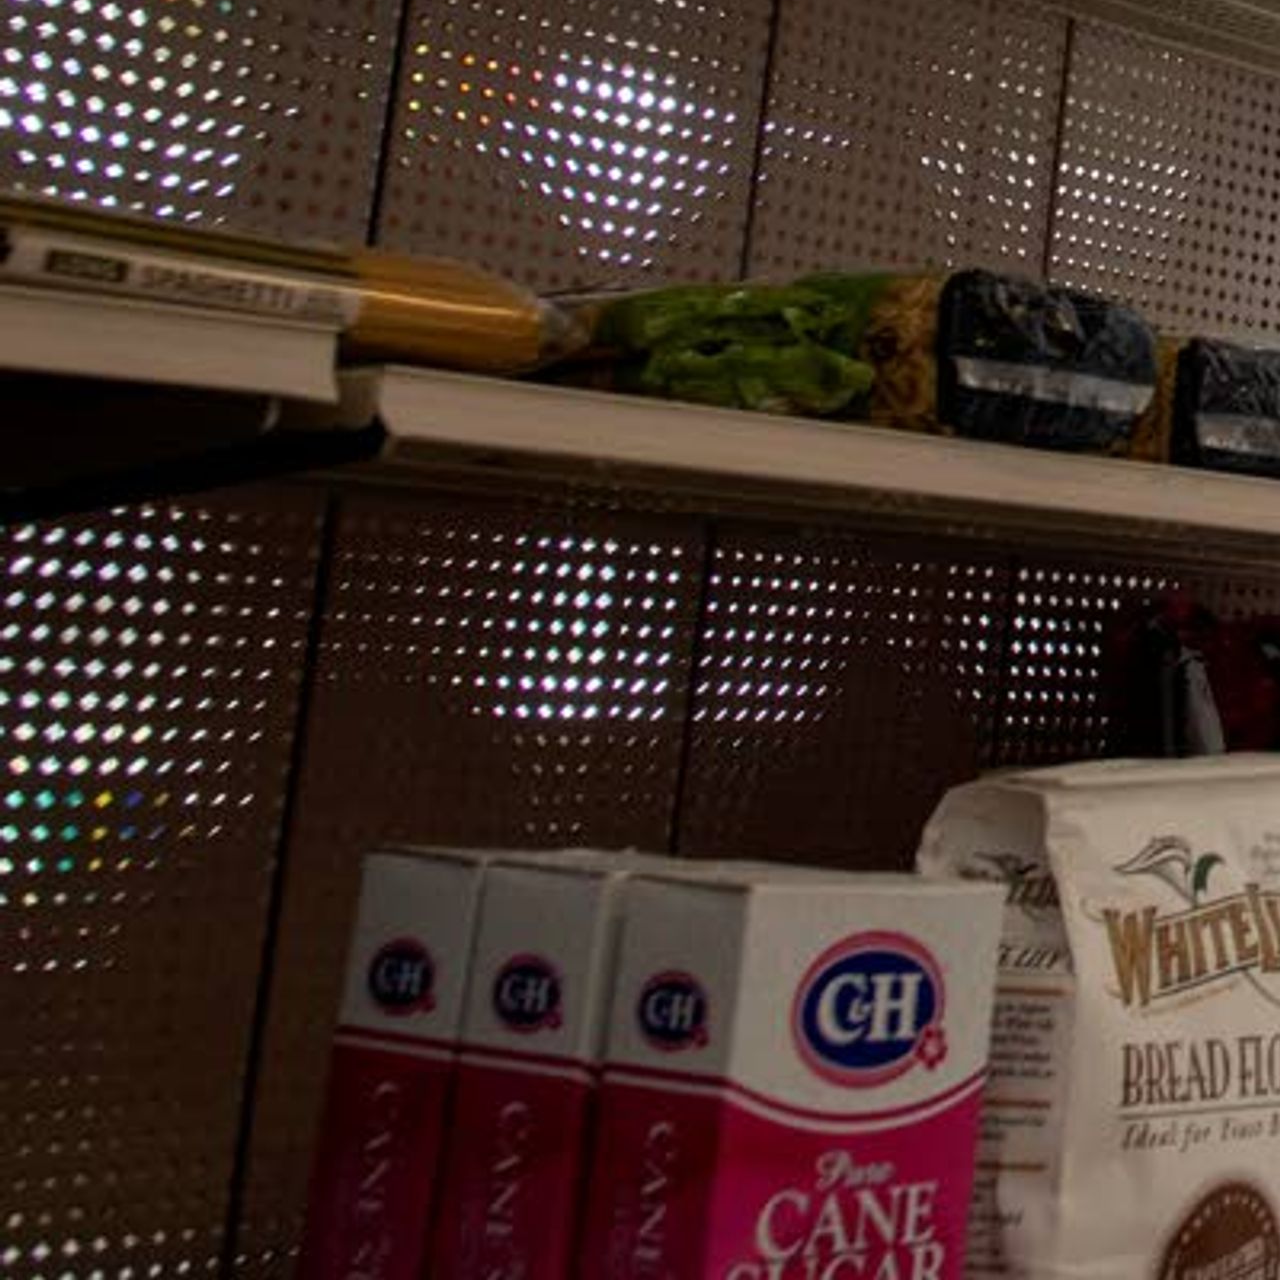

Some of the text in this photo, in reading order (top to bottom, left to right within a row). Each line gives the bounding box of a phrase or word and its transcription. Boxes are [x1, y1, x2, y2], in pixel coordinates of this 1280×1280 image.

[814, 971, 924, 1048] C&H
[1120, 1039, 1231, 1108] BREAD
[754, 1180, 941, 1261] CANE
